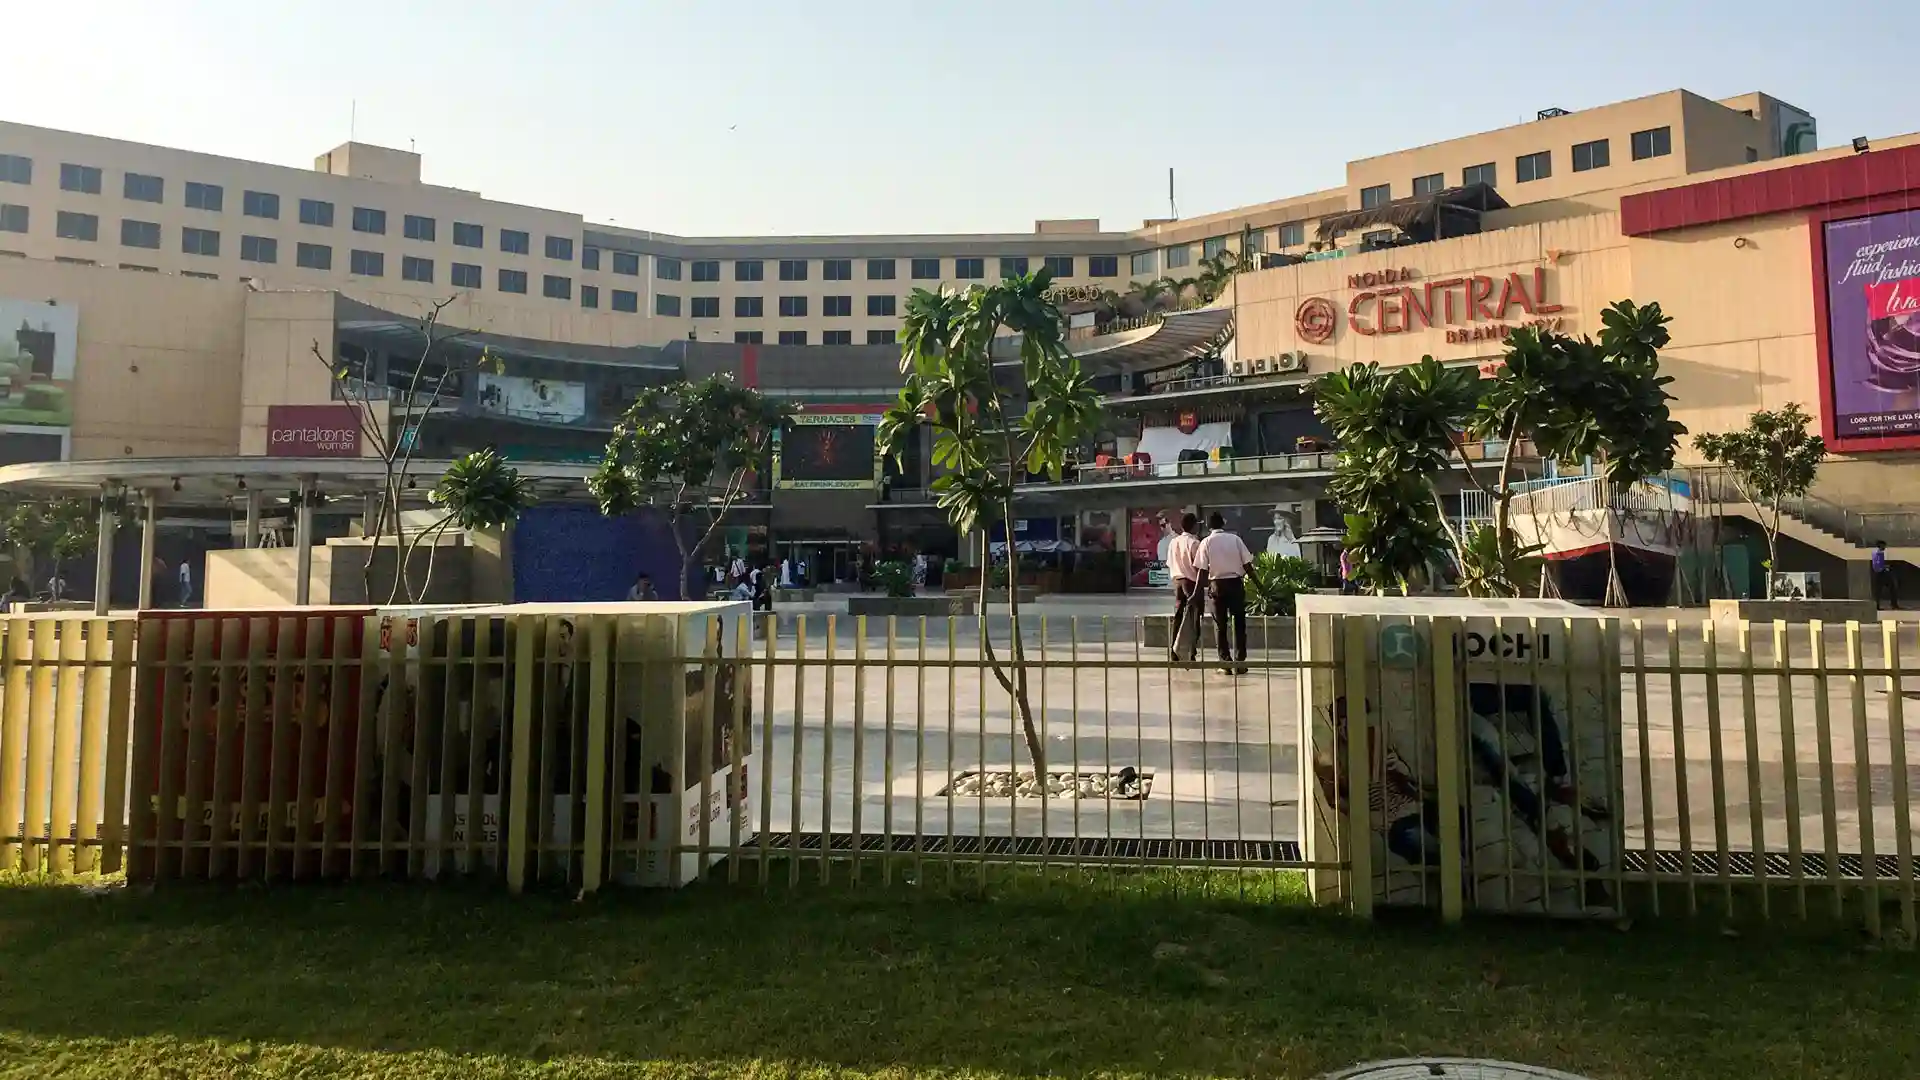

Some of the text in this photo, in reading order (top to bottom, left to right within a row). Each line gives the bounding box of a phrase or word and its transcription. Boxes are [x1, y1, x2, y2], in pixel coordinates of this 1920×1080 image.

[1347, 266, 1411, 289] NOIDA
[1838, 254, 1884, 285] fluid
[1039, 285, 1099, 304] erfecto
[1348, 265, 1563, 336] CENTRAL
[1445, 323, 1511, 344] BRAND
[799, 415, 856, 424] TERRACES
[1850, 416, 1868, 424] LOOK
[1869, 415, 1882, 423] FOR
[1883, 414, 1897, 422] THE
[1898, 413, 1914, 421] LIVA
[272, 426, 355, 444] pantaloons
[317, 441, 354, 451] woman
[1452, 632, 1550, 659] OCHI
